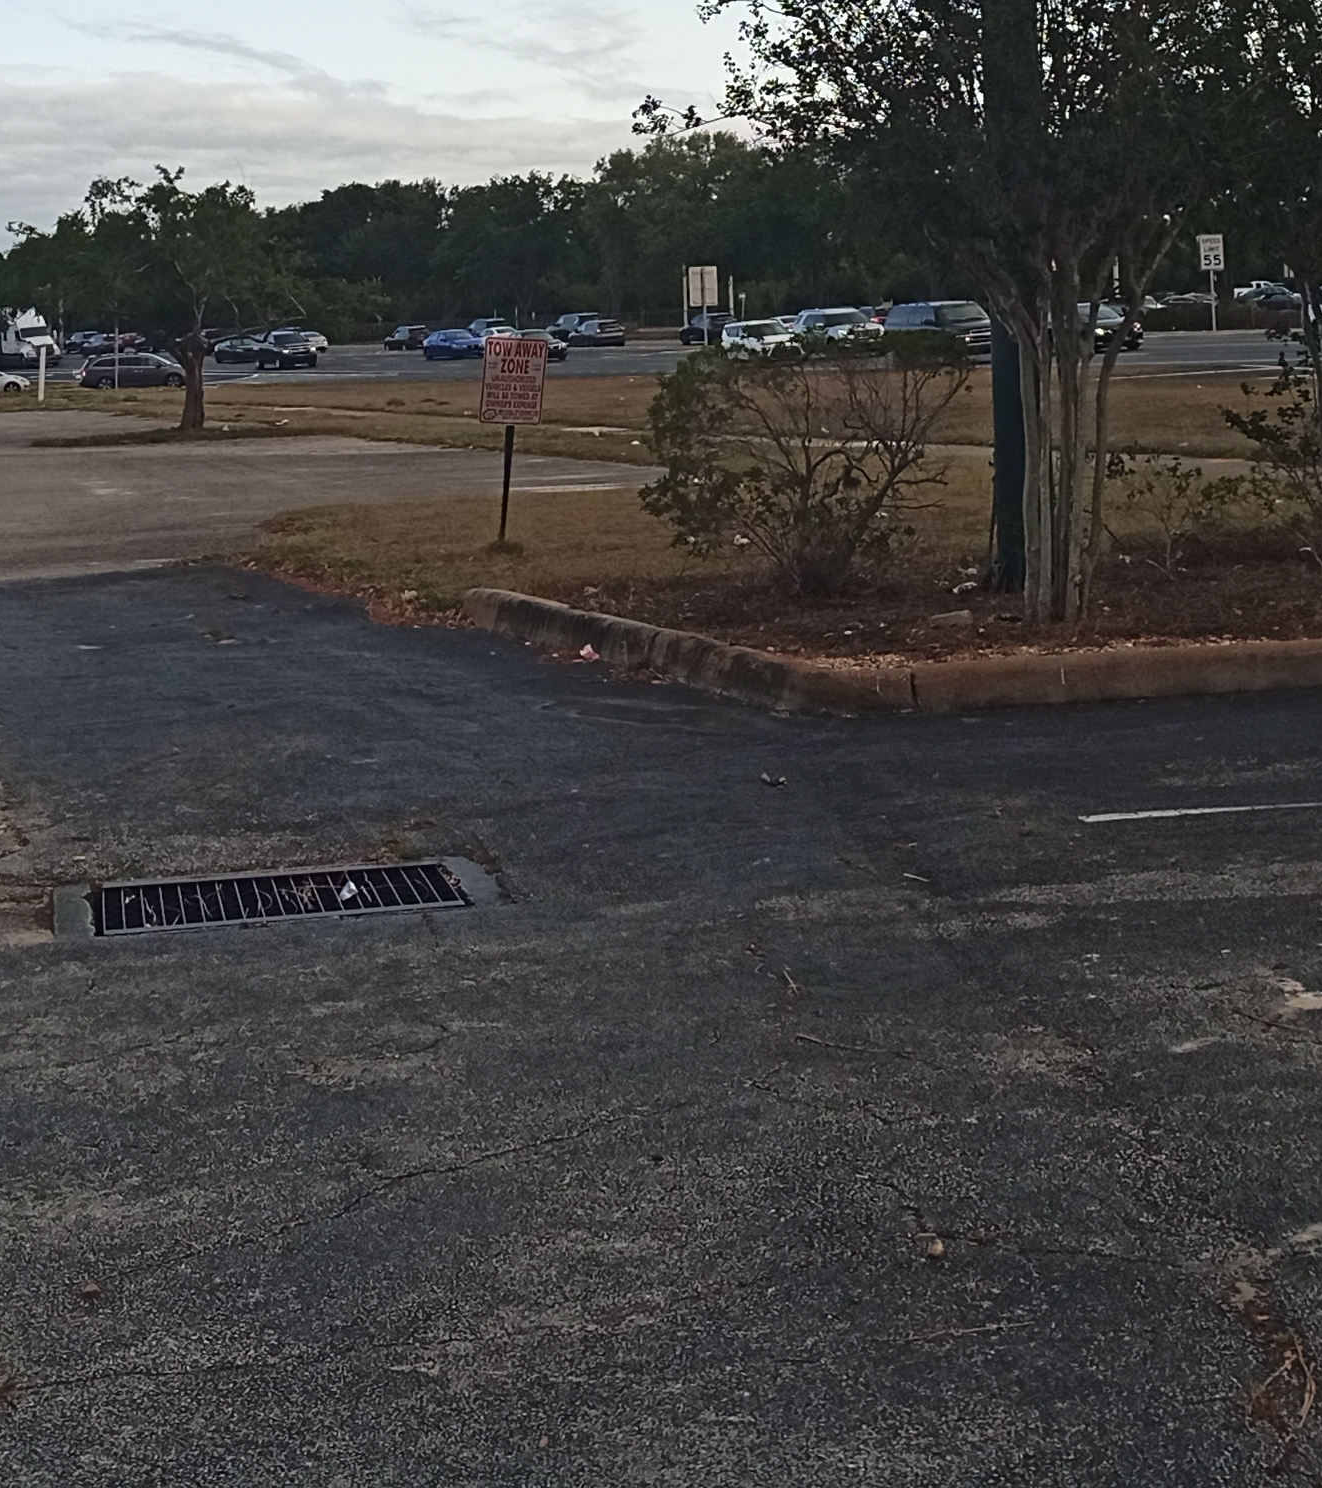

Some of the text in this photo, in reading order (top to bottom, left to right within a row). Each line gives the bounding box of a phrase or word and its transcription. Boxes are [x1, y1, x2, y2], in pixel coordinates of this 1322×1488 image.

[1203, 254, 1222, 266] 55
[488, 341, 545, 358] TOW AWAY
[500, 358, 530, 374] ZONE
[491, 375, 536, 383] UNAUTHORIZED
[485, 383, 511, 391] VEHICLES
[513, 383, 517, 391] &
[510, 392, 530, 400] TOWED
[513, 401, 537, 409] EXPENSE
